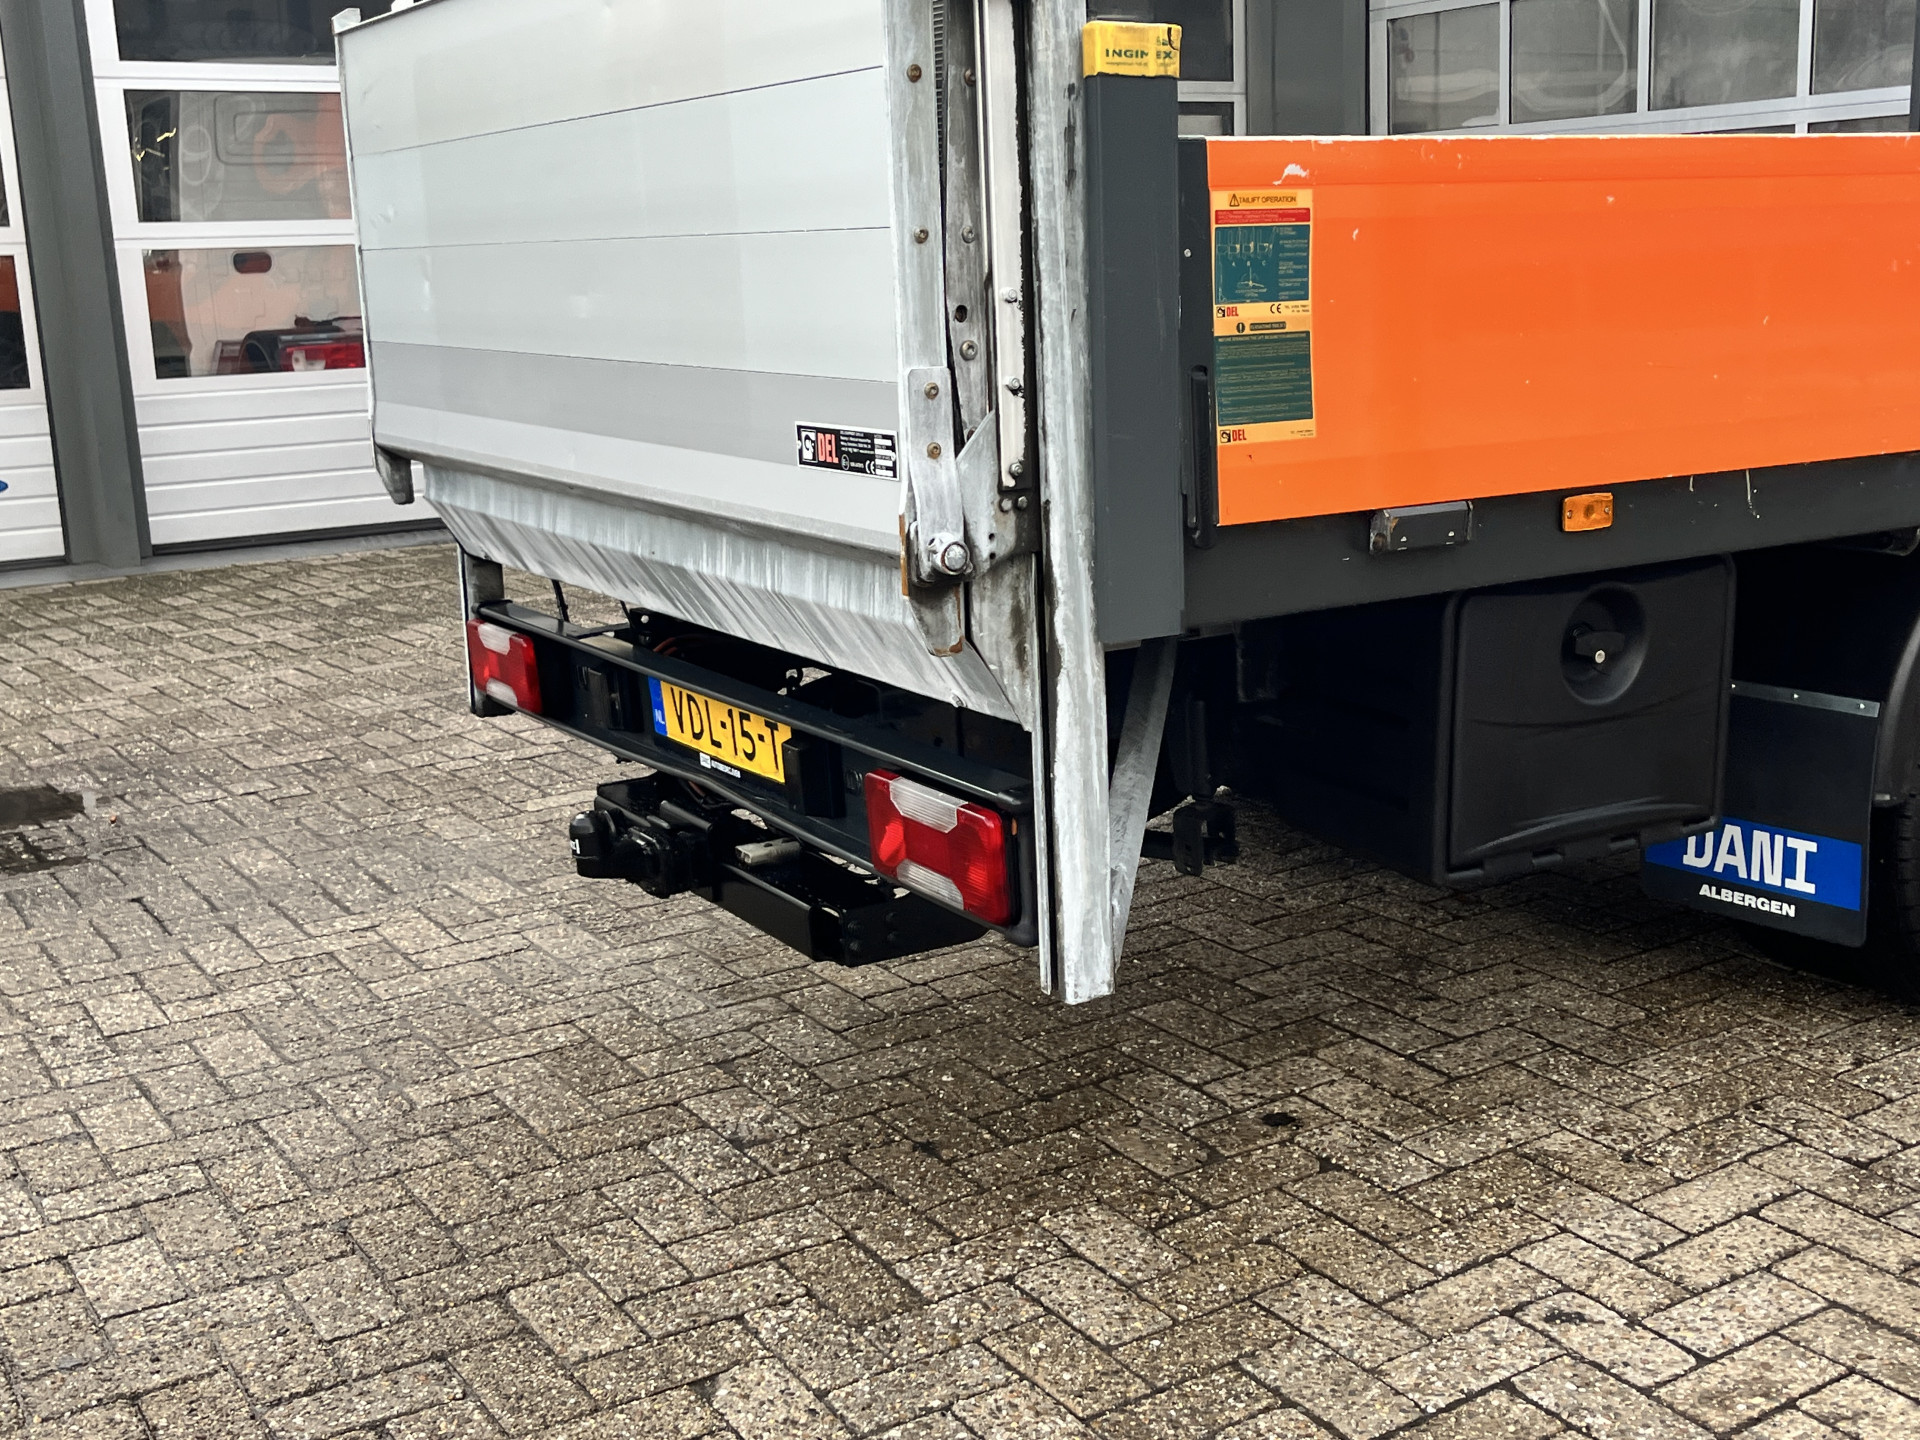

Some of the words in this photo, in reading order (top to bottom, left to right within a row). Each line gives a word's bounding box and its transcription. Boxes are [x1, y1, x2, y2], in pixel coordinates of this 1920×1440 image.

[1261, 195, 1297, 203] OPERATION
[1226, 306, 1239, 317] DEL
[1231, 429, 1247, 442] DEL
[817, 432, 839, 464] DEL
[654, 708, 665, 725] NL
[670, 686, 779, 771] VDL-15-T
[1682, 823, 1818, 895] DANI
[1699, 883, 1796, 918] ALBERGEN
